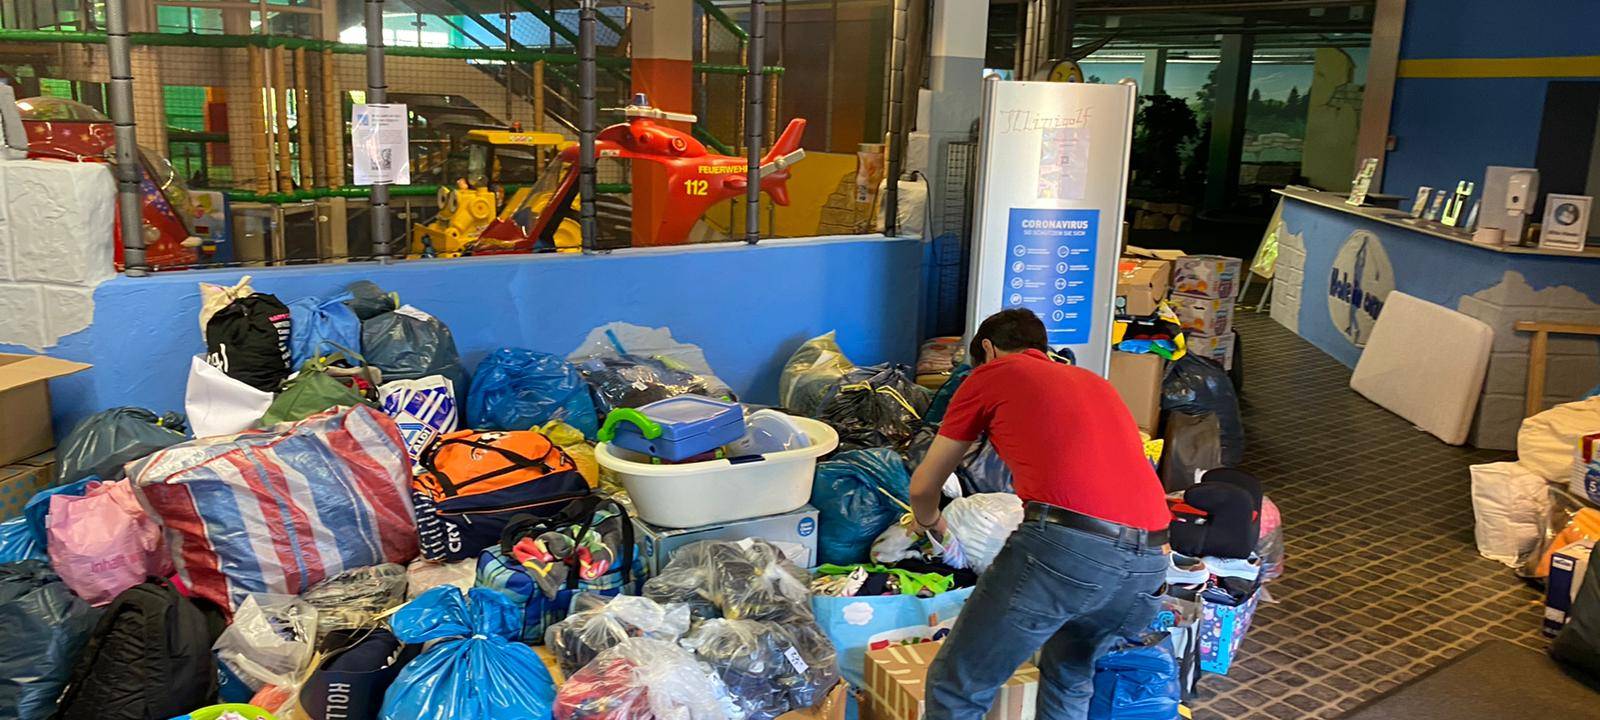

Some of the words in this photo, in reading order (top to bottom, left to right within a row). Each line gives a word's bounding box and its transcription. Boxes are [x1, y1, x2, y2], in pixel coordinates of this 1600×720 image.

[684, 180, 708, 195] 112
[1022, 220, 1088, 229] CORONAVIRUS
[412, 427, 432, 453] ALDI
[446, 522, 461, 552] CRY
[325, 683, 351, 720] HOLL
